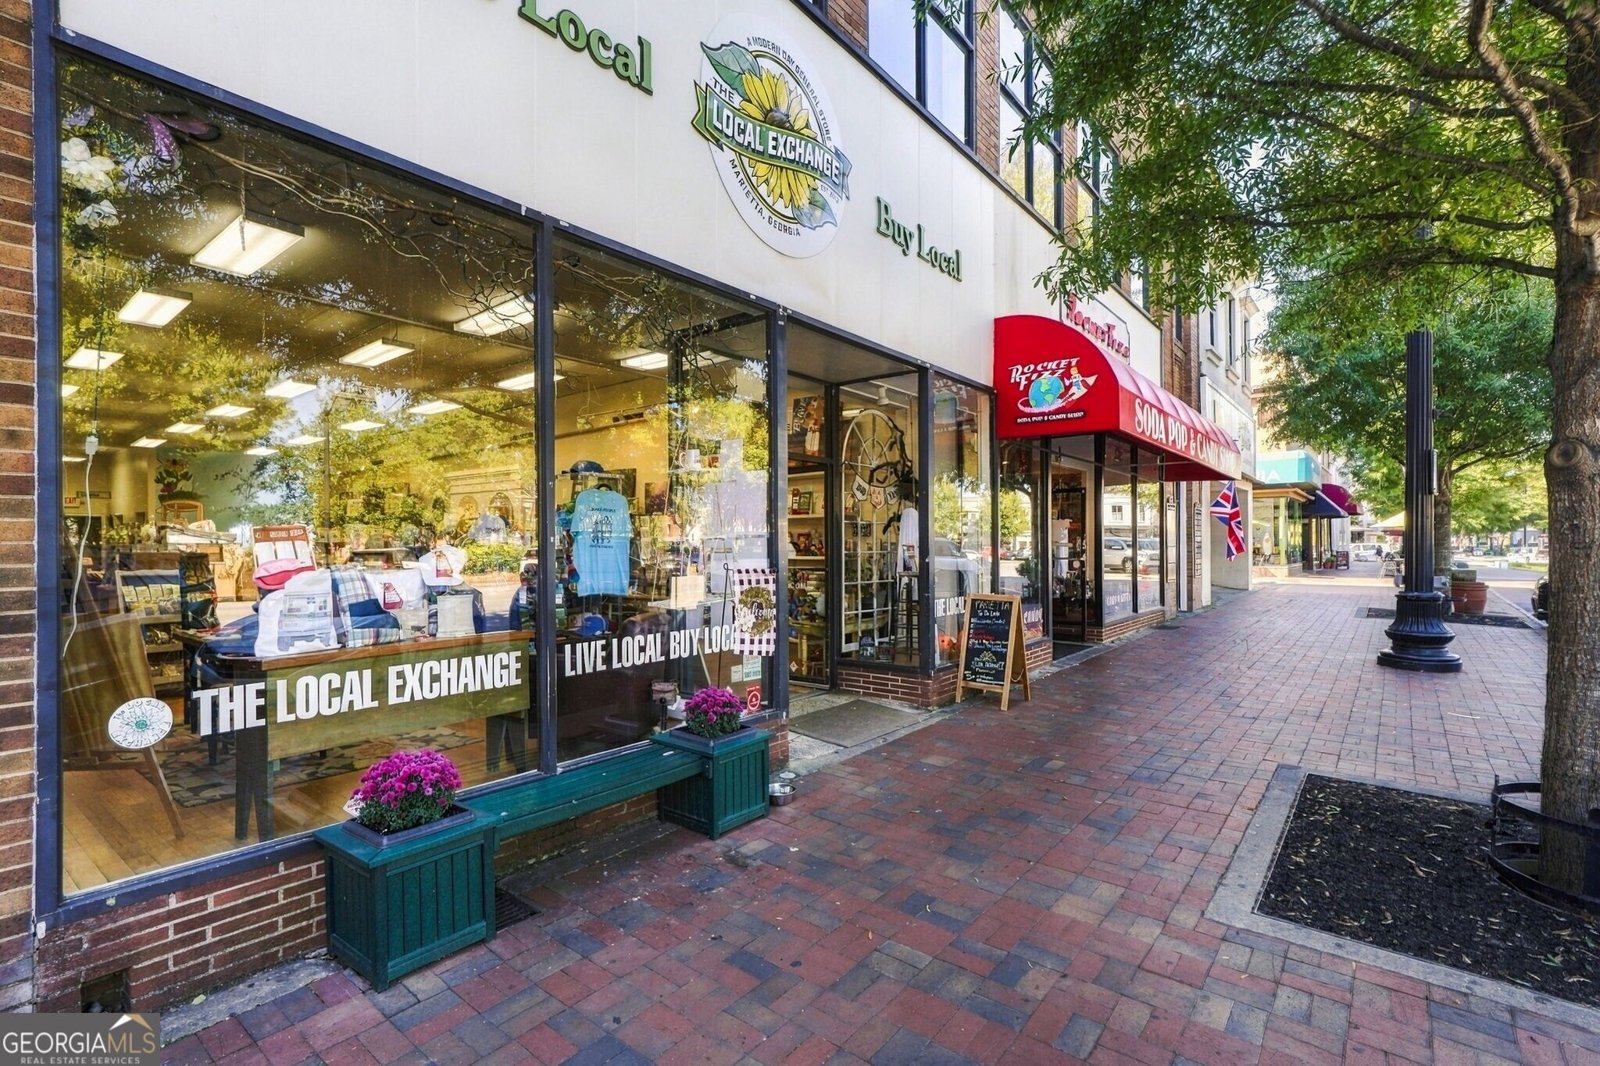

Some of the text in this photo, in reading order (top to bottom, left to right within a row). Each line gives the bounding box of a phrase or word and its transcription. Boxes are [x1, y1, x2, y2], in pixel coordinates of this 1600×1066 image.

[712, 77, 735, 103] THE
[752, 36, 781, 55] MODERN
[782, 50, 795, 65] DAY
[795, 64, 819, 108] GENERAL
[819, 109, 832, 142] STORE
[713, 99, 841, 186] LOCAL EXCHANGE
[767, 215, 801, 237] GEORGIA
[876, 196, 962, 282] Buy Local
[1008, 357, 1080, 383] ROCKET
[1017, 369, 1066, 391] FIZZ
[1135, 398, 1166, 444] SODA
[1167, 416, 1188, 452] POP
[1190, 429, 1196, 456] &
[1197, 433, 1220, 468] CANDY
[564, 624, 735, 677] LIVE LOCAL BUY LOC
[193, 682, 266, 736] THE
[276, 669, 379, 723] LOCAL
[388, 651, 522, 705] EXCHANGE
